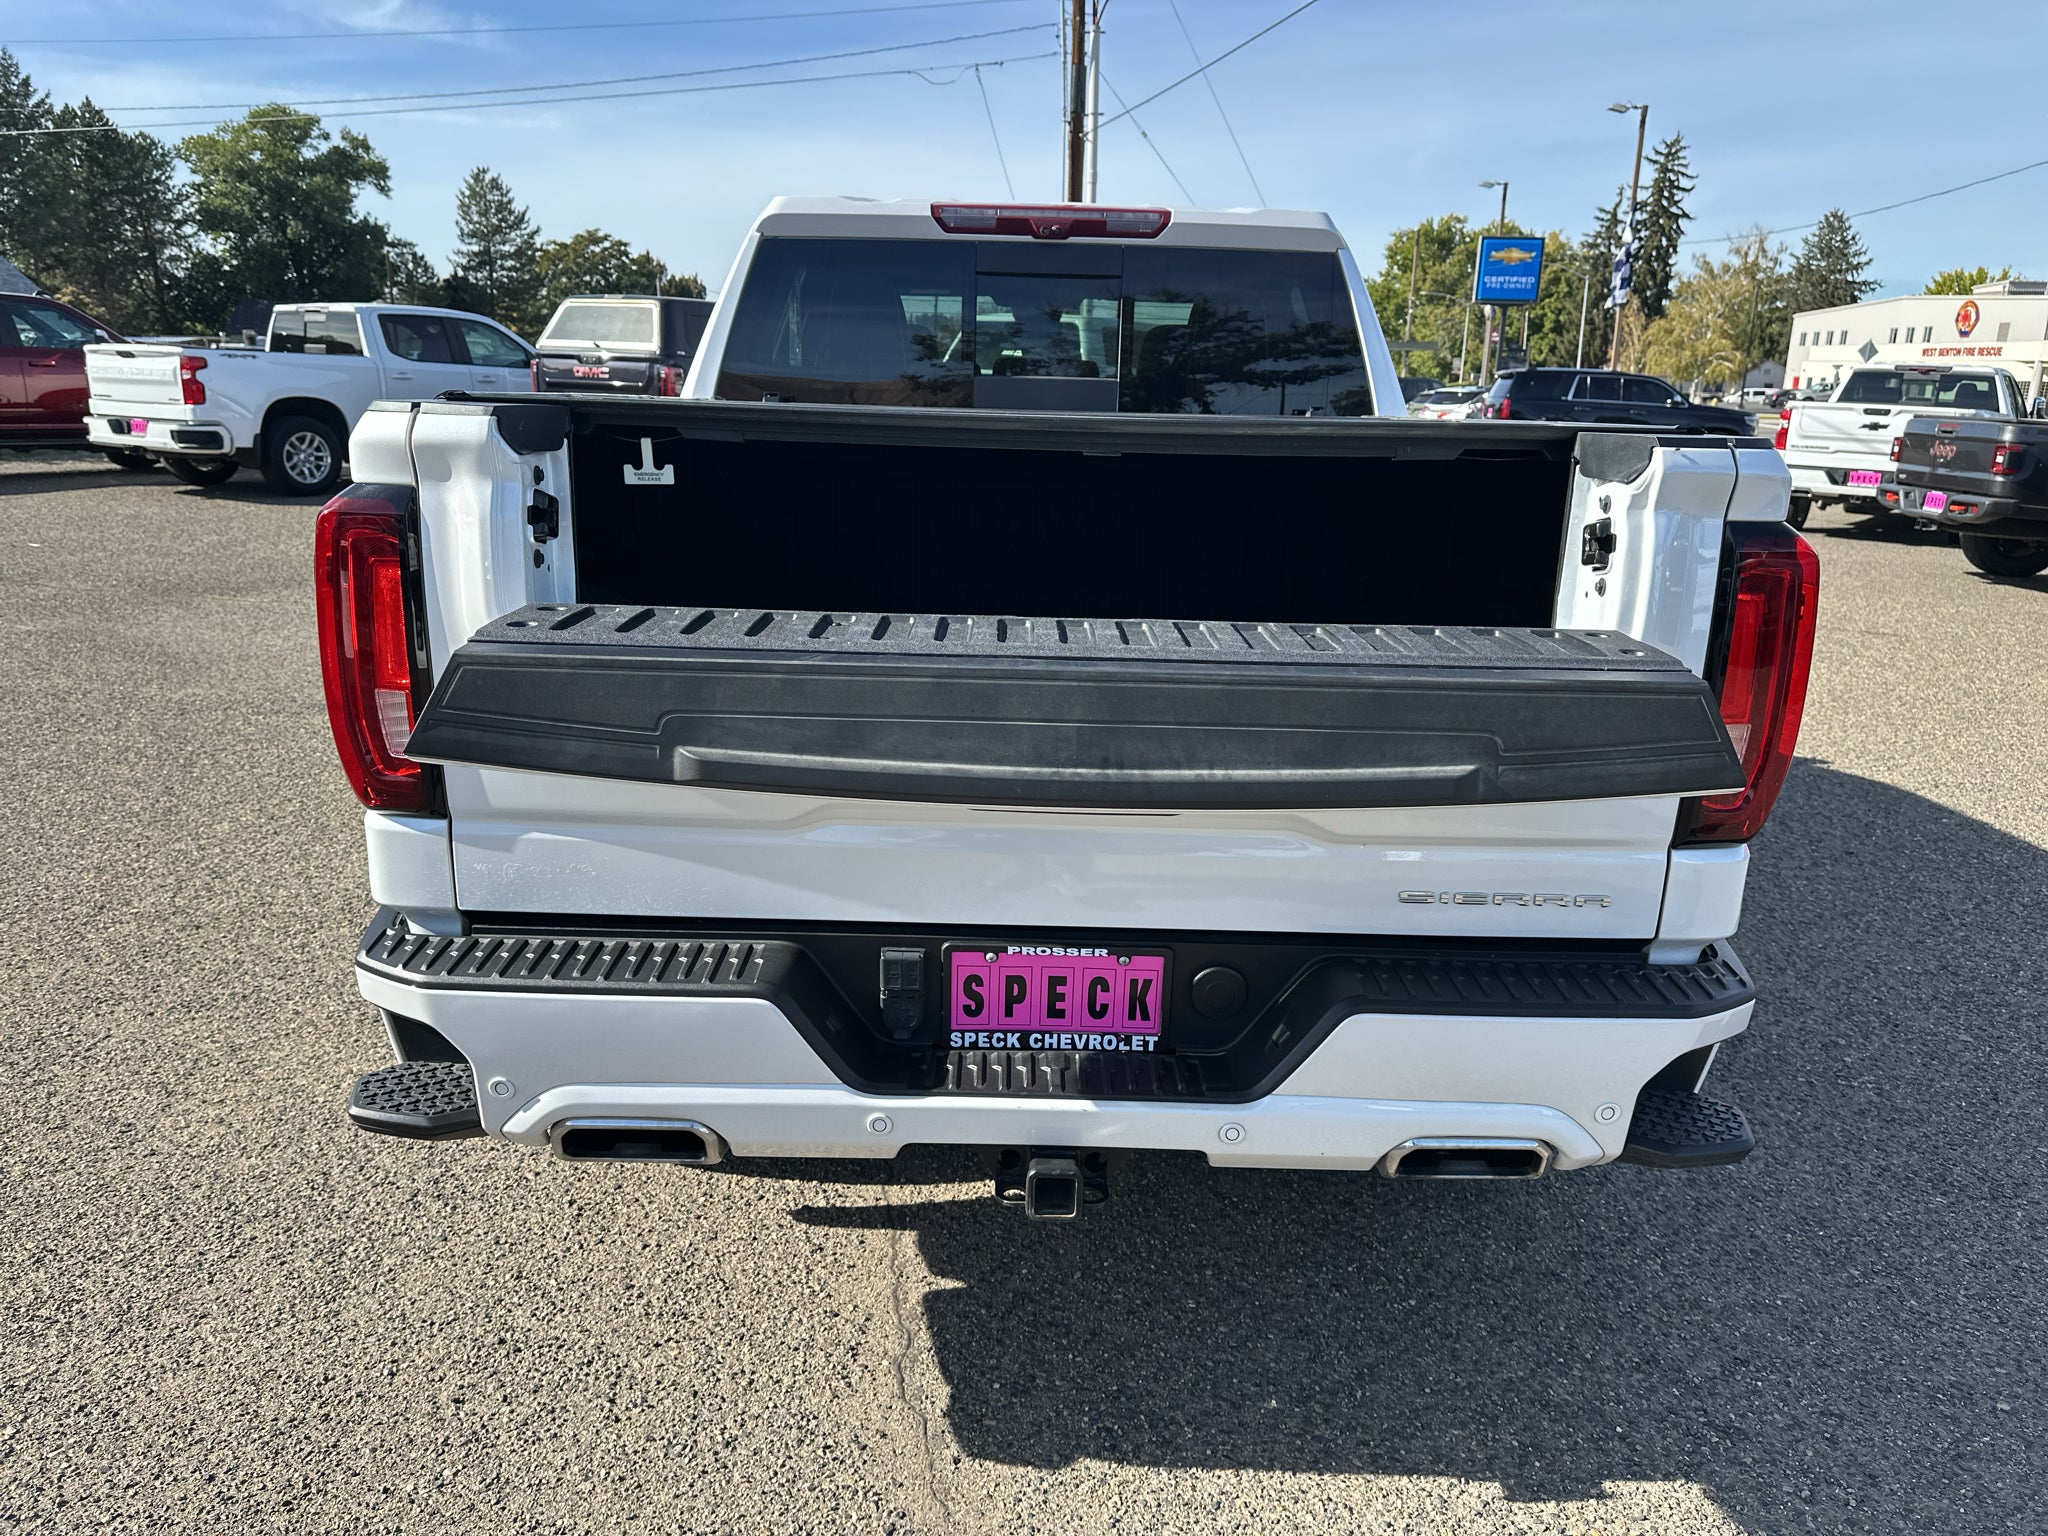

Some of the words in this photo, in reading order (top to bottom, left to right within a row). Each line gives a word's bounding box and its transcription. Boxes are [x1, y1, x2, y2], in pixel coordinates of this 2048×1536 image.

[1484, 275, 1536, 283] CERTIFIED
[1922, 347, 1937, 357] WEST
[1938, 347, 1962, 357] BENTON
[1962, 346, 1976, 357] FIRE
[1977, 346, 2003, 357] RESCUE
[572, 366, 609, 378] GMC
[1930, 440, 1957, 460] Jeep
[1399, 890, 1612, 908] SIERRA
[1007, 945, 1109, 957] PROSSER
[962, 974, 1153, 1021] SPECK
[950, 1031, 1021, 1049] SPECK
[1029, 1033, 1159, 1052] CHEVROLET
